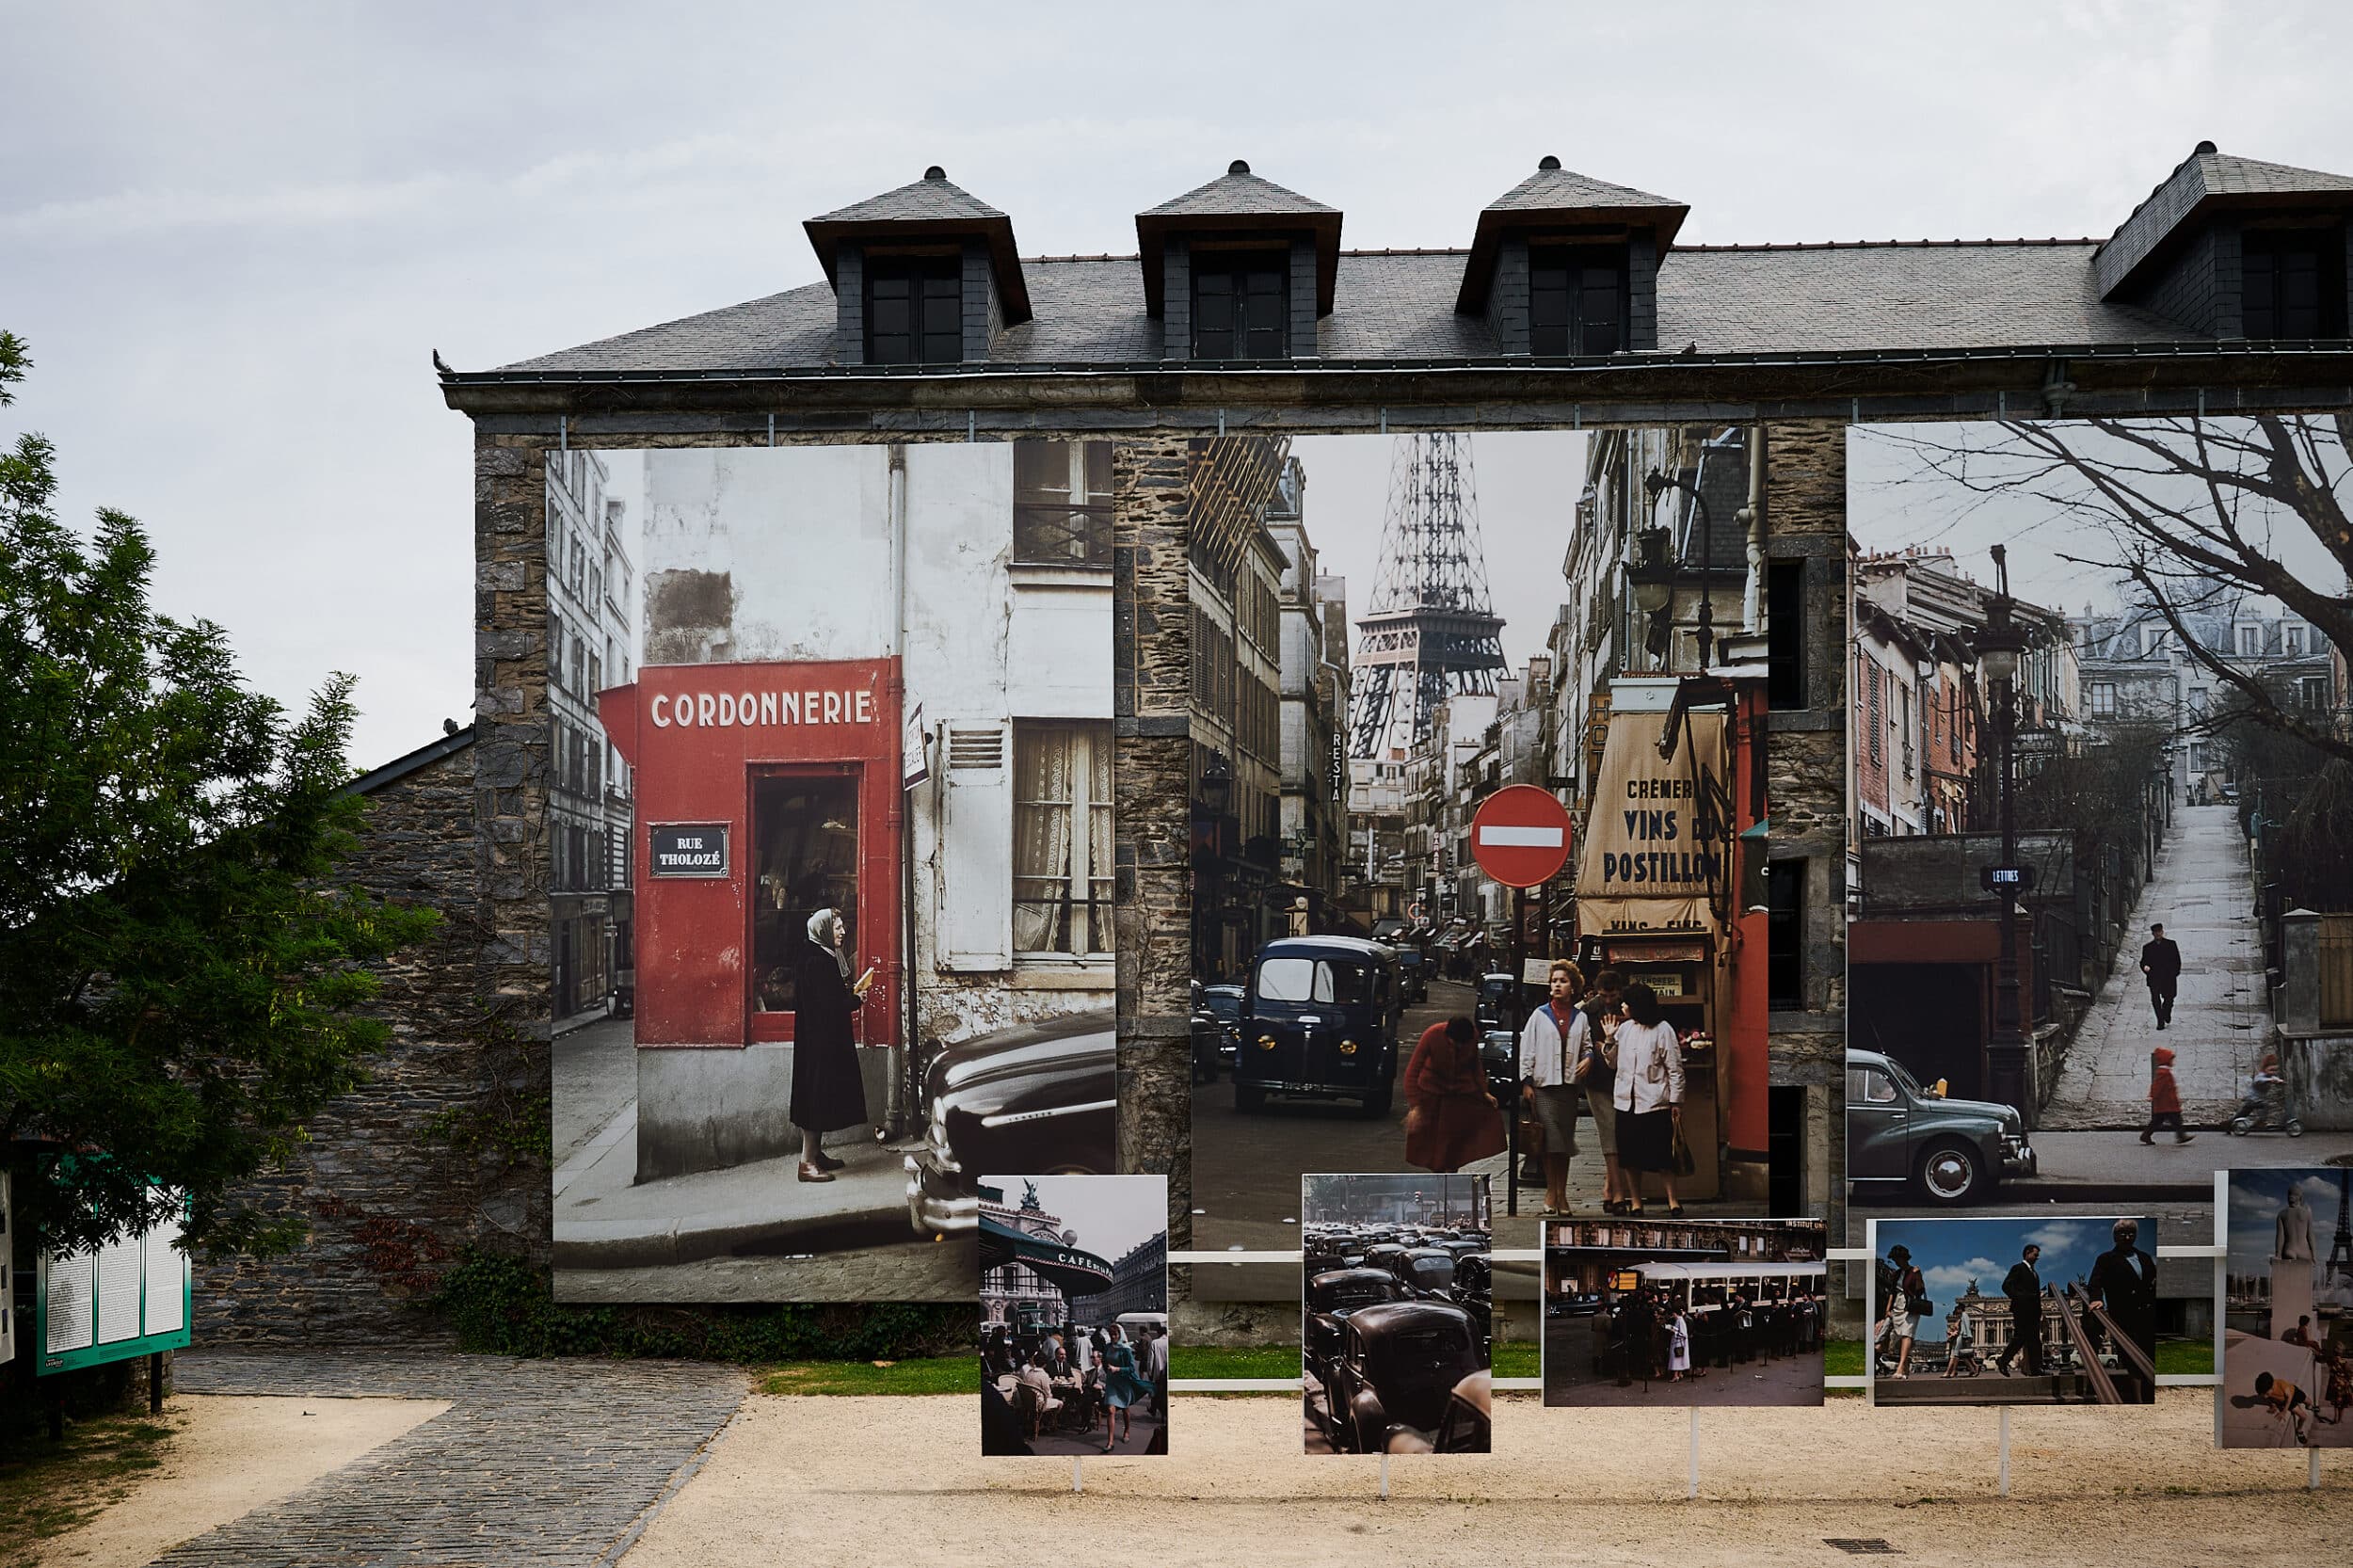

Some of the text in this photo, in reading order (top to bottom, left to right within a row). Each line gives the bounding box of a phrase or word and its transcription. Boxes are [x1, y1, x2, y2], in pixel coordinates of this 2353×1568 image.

[651, 690, 872, 728] CORDONNERIE
[1624, 809, 1678, 841] VINS
[659, 851, 721, 866] THOLOZÉ
[677, 838, 703, 851] RUE
[1603, 852, 1722, 883] POSTILLON
